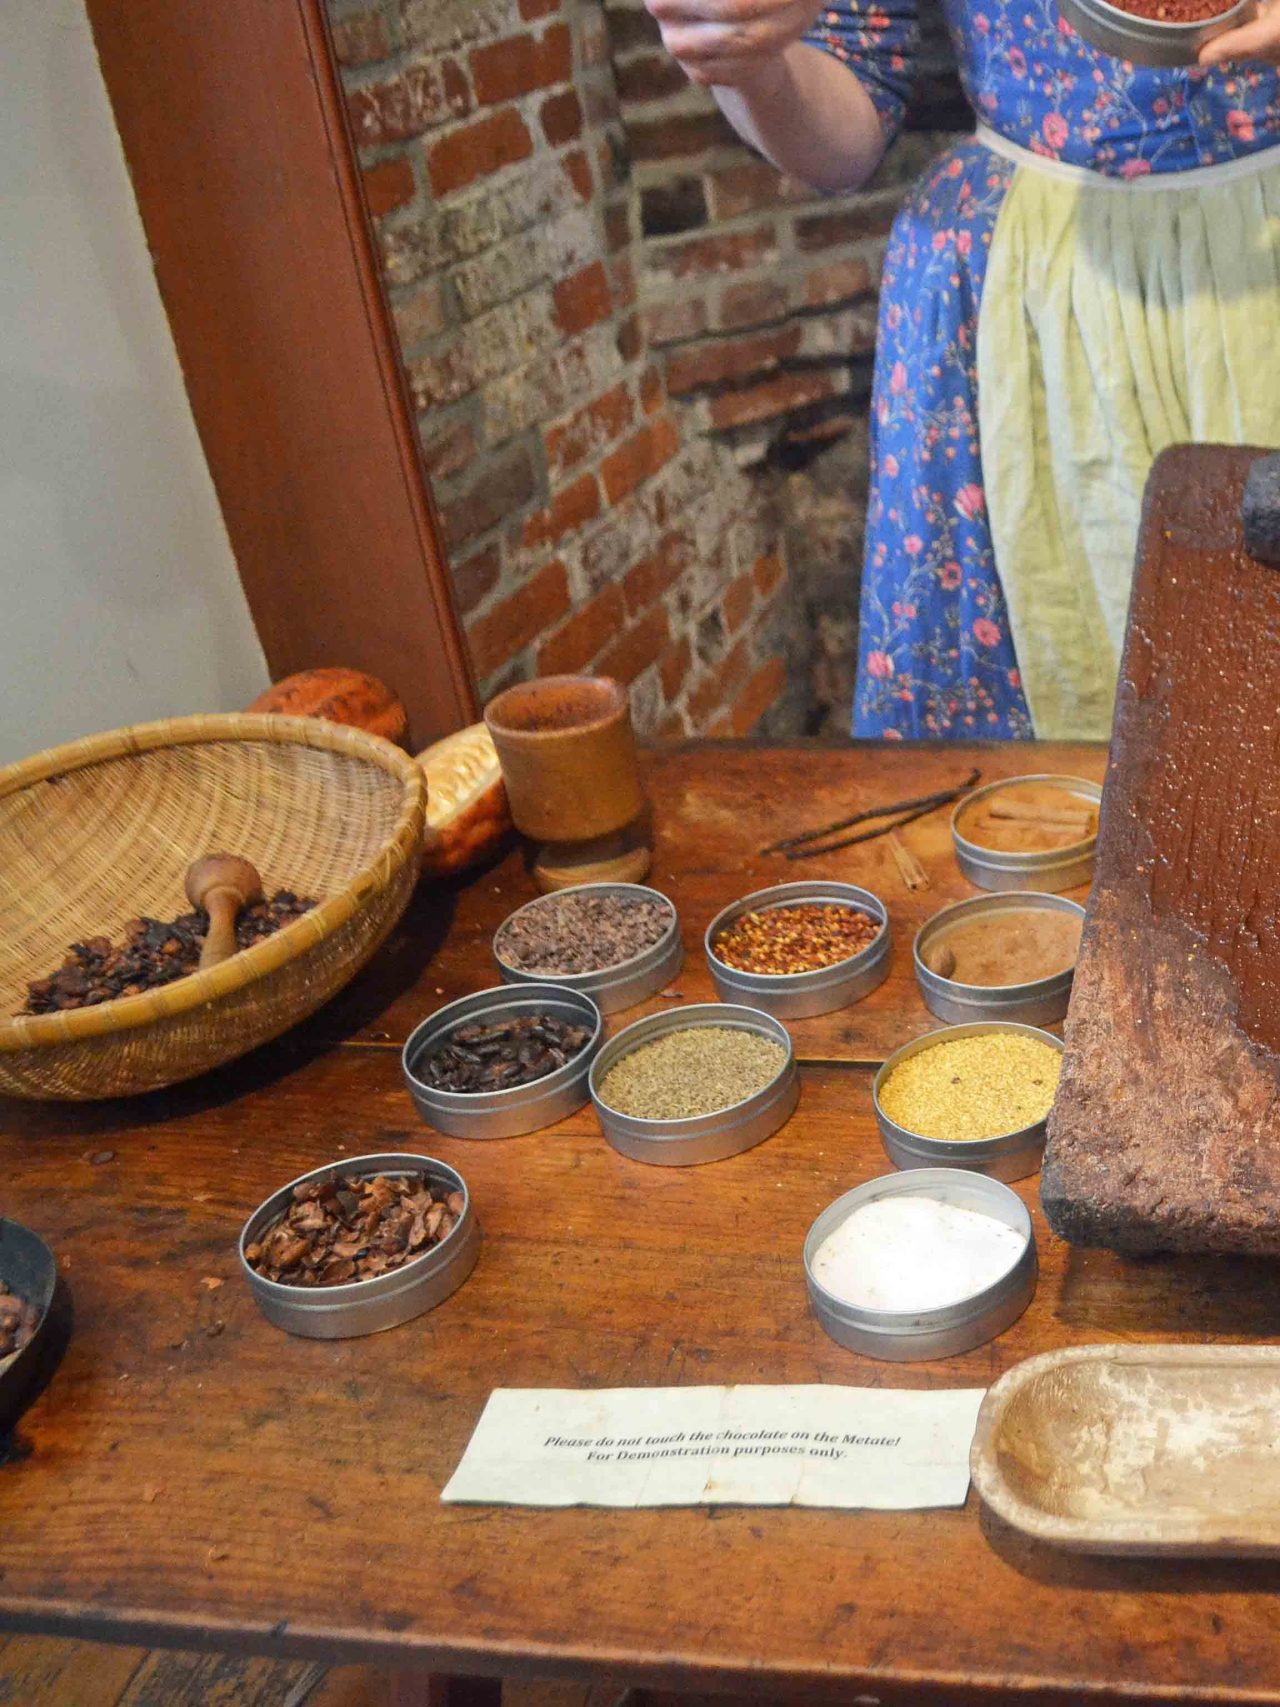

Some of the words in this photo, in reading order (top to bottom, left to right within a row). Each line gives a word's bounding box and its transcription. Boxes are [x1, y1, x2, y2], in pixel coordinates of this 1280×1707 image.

[543, 1436, 593, 1448] Please
[595, 1436, 614, 1447] do
[616, 1436, 643, 1447] not
[645, 1432, 686, 1446] touch
[688, 1431, 714, 1442] the
[716, 1429, 789, 1441] chocolate
[790, 1431, 810, 1441] on
[813, 1431, 839, 1444] the
[841, 1433, 902, 1447] Metate!
[586, 1450, 614, 1461] For
[616, 1445, 730, 1461] Demonstration
[732, 1445, 806, 1457] purposes
[809, 1447, 848, 1460] only.
